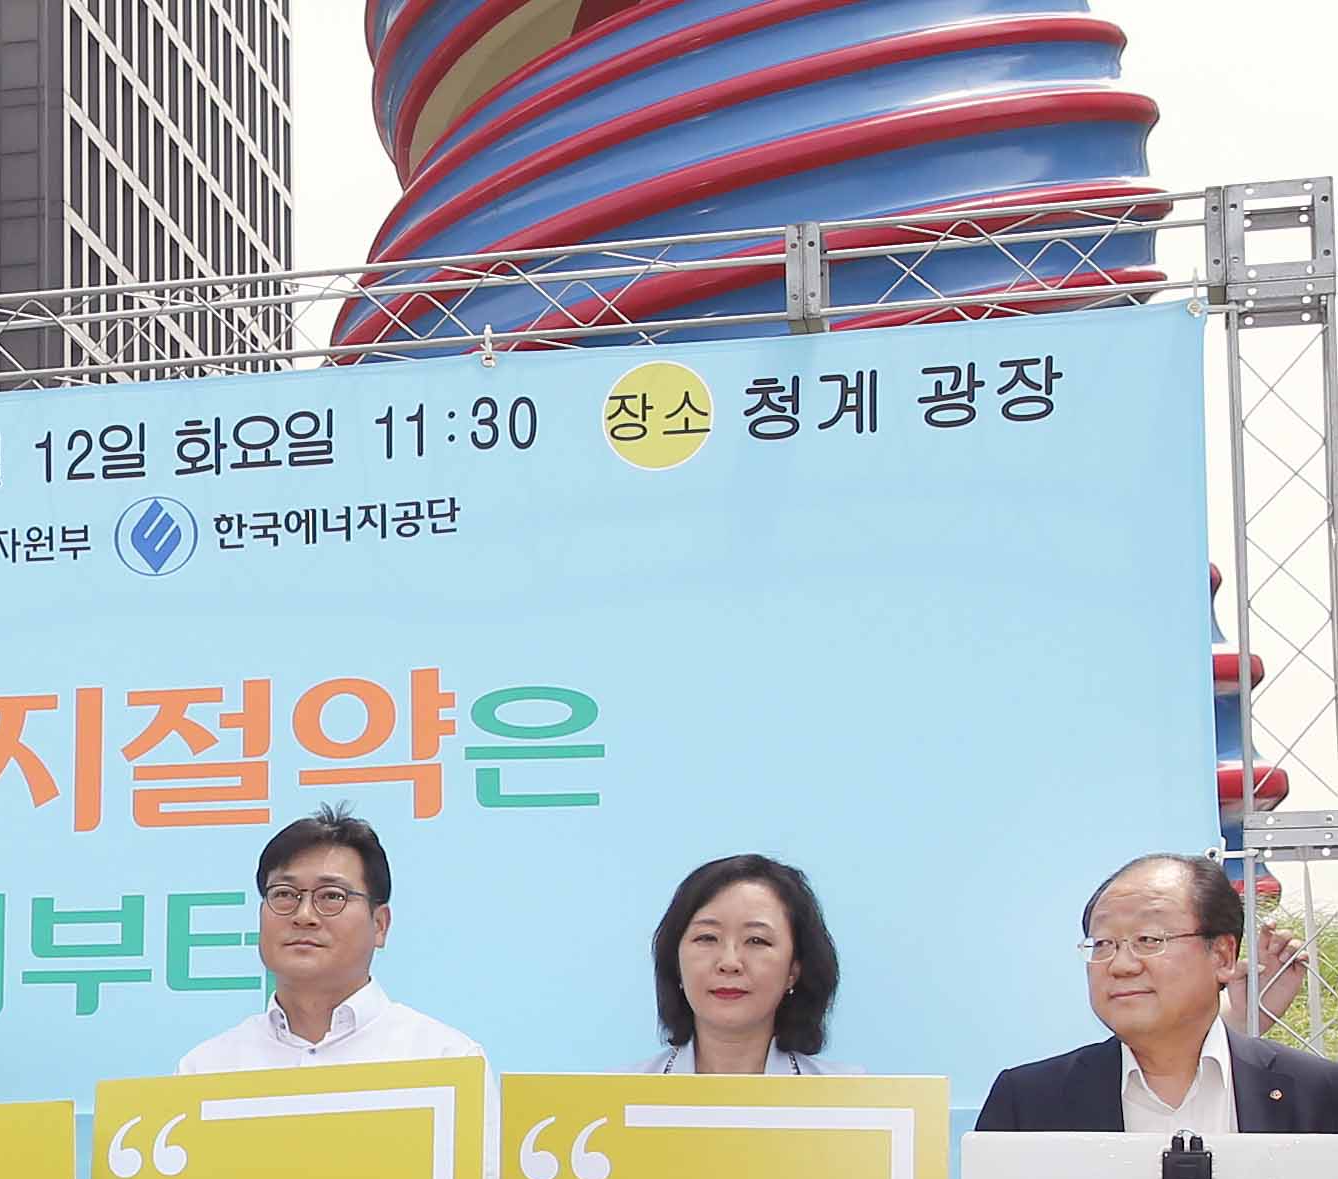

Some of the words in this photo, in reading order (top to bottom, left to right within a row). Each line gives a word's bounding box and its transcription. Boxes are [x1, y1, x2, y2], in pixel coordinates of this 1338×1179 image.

[607, 391, 711, 442] 장소
[744, 368, 880, 441] 청계
[916, 354, 1064, 427] 광장
[34, 420, 147, 482] 12일
[174, 408, 335, 476] 화요일
[374, 395, 538, 461] 11:30
[212, 496, 460, 551] 한국에너지공단
